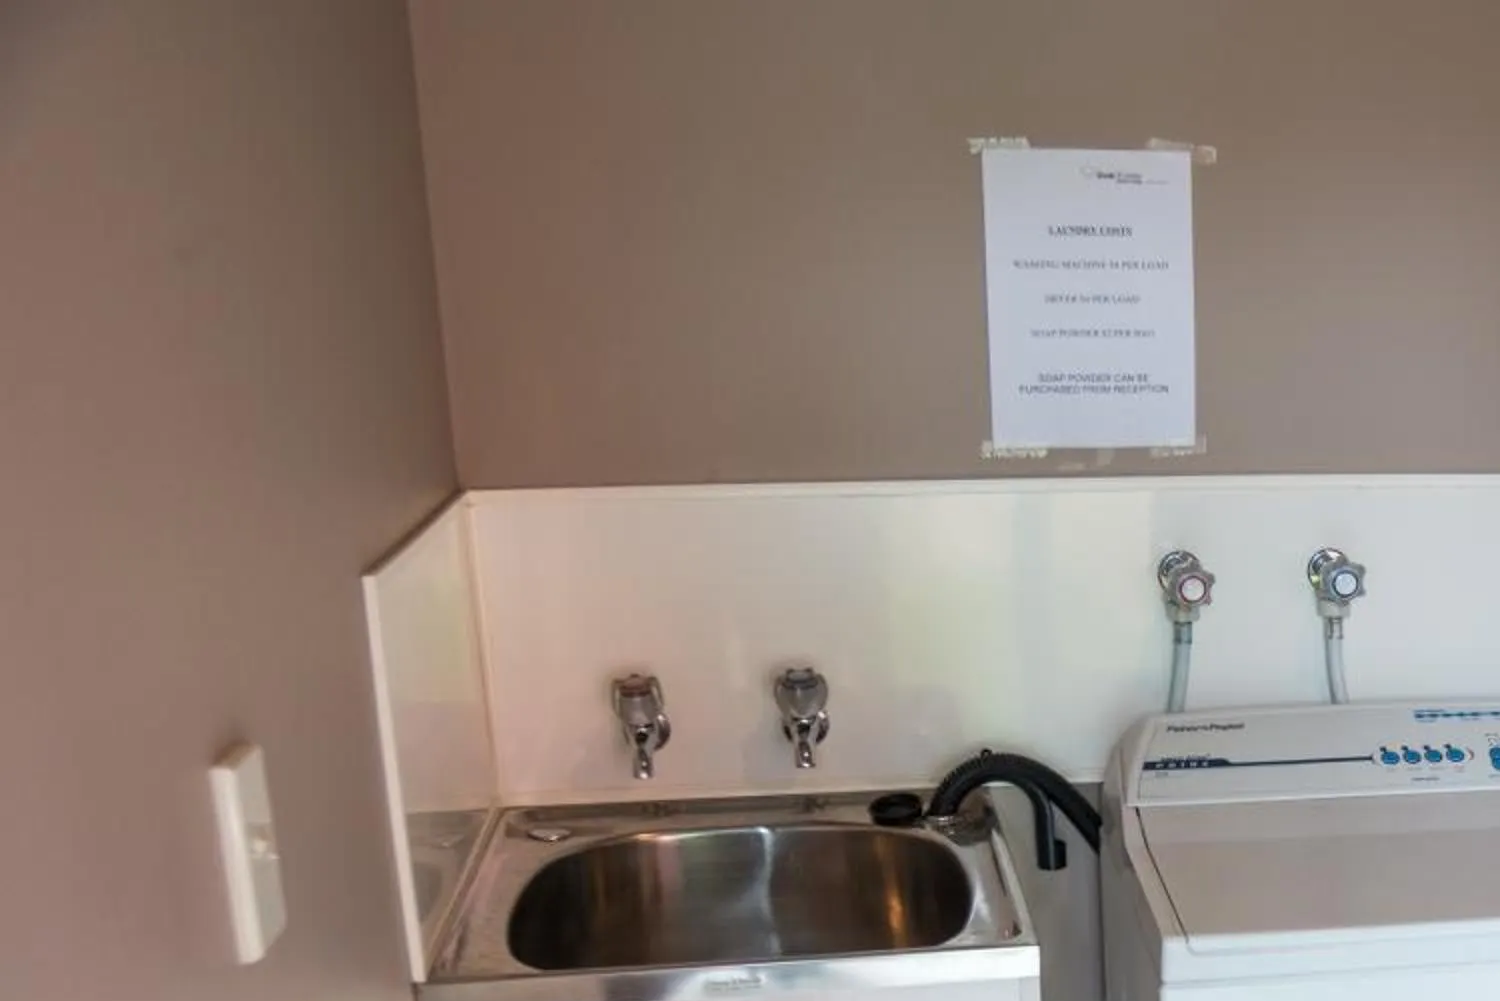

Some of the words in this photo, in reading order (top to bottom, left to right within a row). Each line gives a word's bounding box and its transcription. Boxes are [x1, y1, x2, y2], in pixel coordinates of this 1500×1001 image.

[1038, 373, 1066, 383] SOAP
[1068, 373, 1112, 383] POWDER
[1113, 373, 1135, 383] CAN
[1136, 373, 1149, 383] BE
[1018, 384, 1081, 395] PURCHASED
[1082, 384, 1111, 394] FROM
[1113, 384, 1170, 395] RECEPTION
